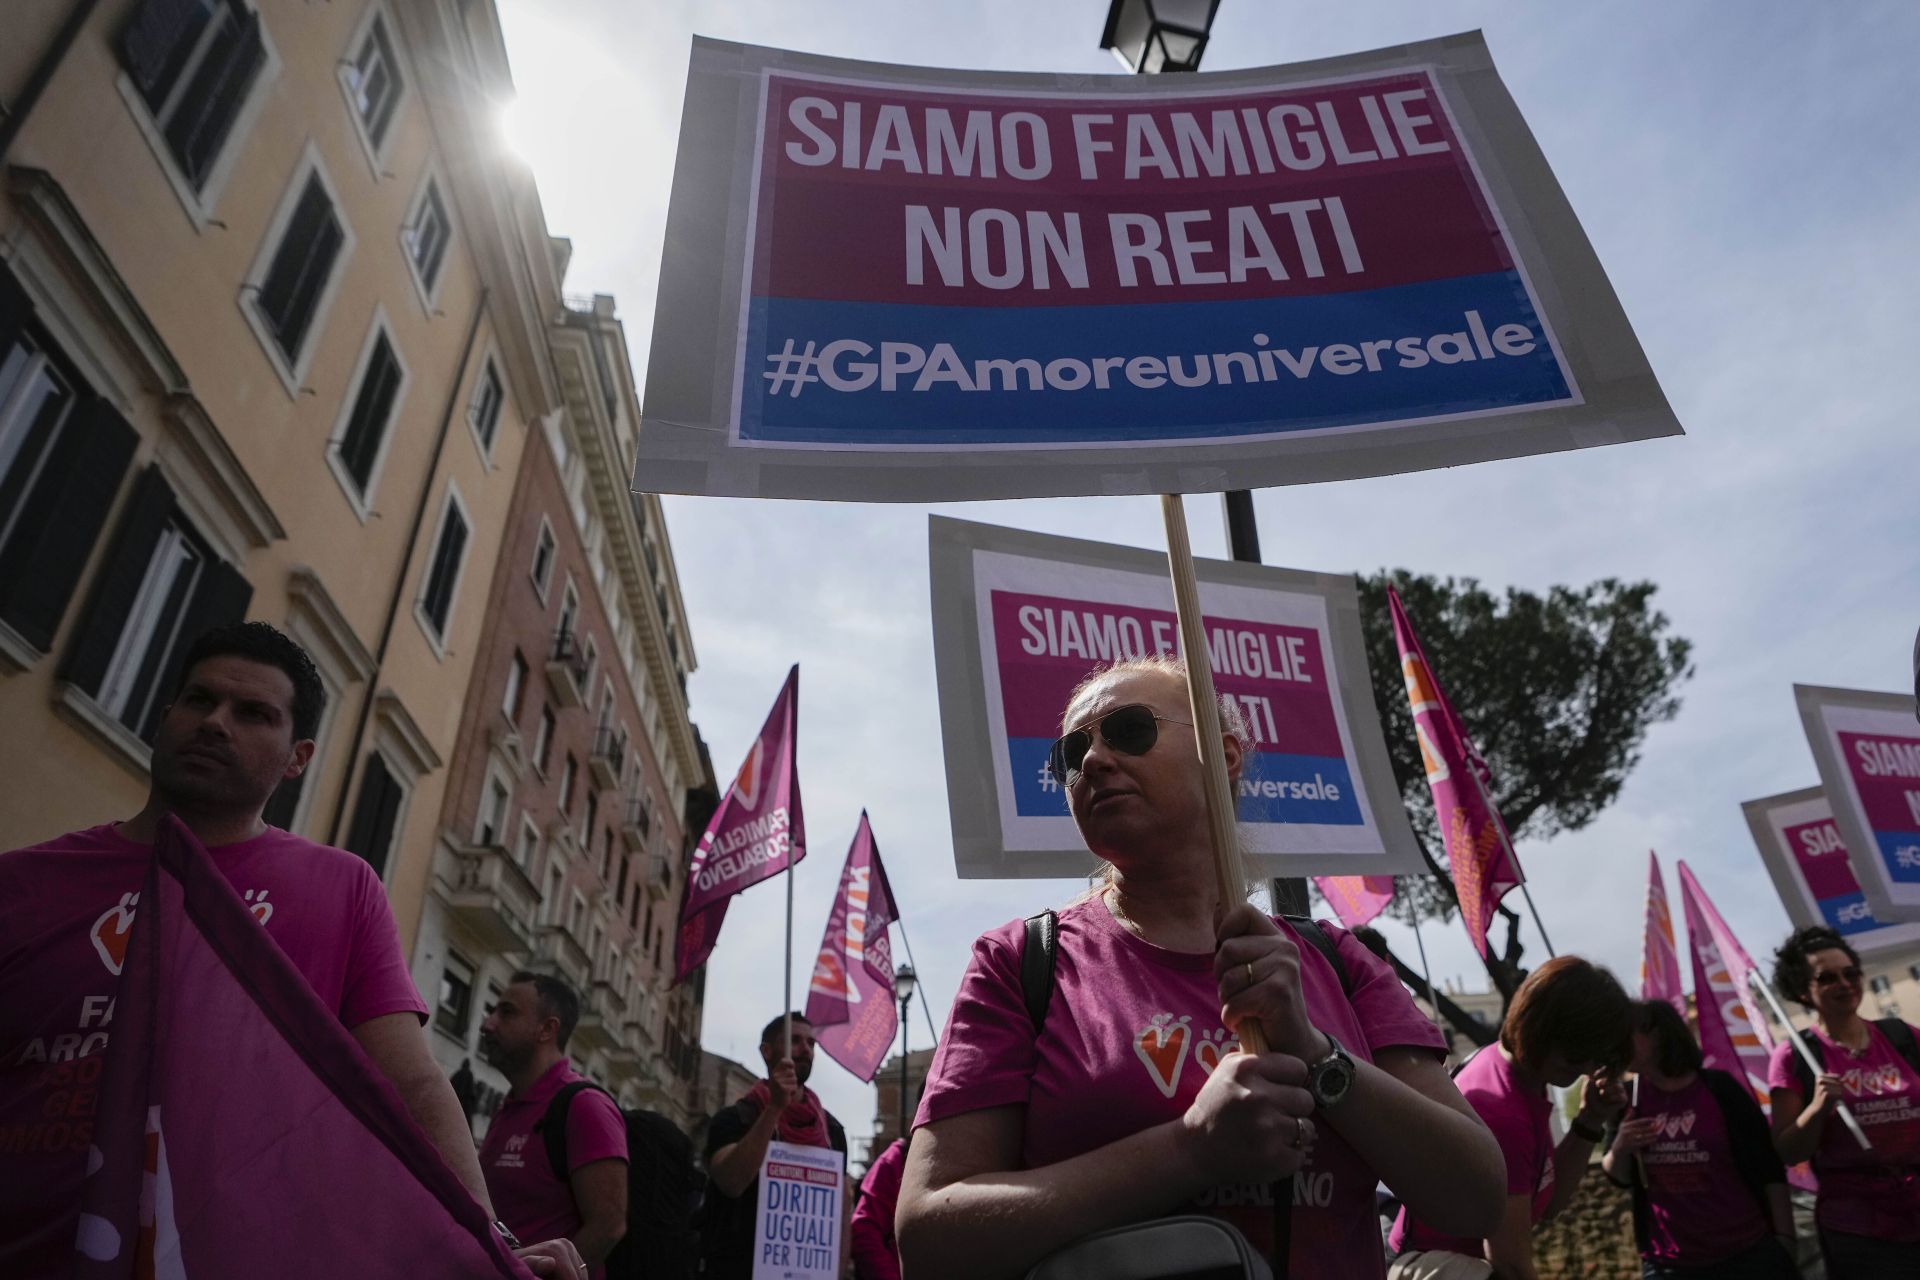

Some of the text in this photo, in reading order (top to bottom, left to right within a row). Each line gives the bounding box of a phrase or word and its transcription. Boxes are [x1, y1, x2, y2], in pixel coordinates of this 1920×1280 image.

[785, 88, 1451, 181] SIAMO FAMIGLIE
[905, 196, 1365, 290] NON REATI
[763, 310, 1537, 398] #GPAmoreuniversale
[1018, 604, 1312, 683] SIAMO FMIGLIE
[1855, 740, 1920, 778] SIAM
[1800, 824, 1847, 856] SIA
[767, 1181, 834, 1218] DIRITTI
[765, 1212, 833, 1247] UGUALI
[763, 1243, 832, 1271] PER TUTTI
